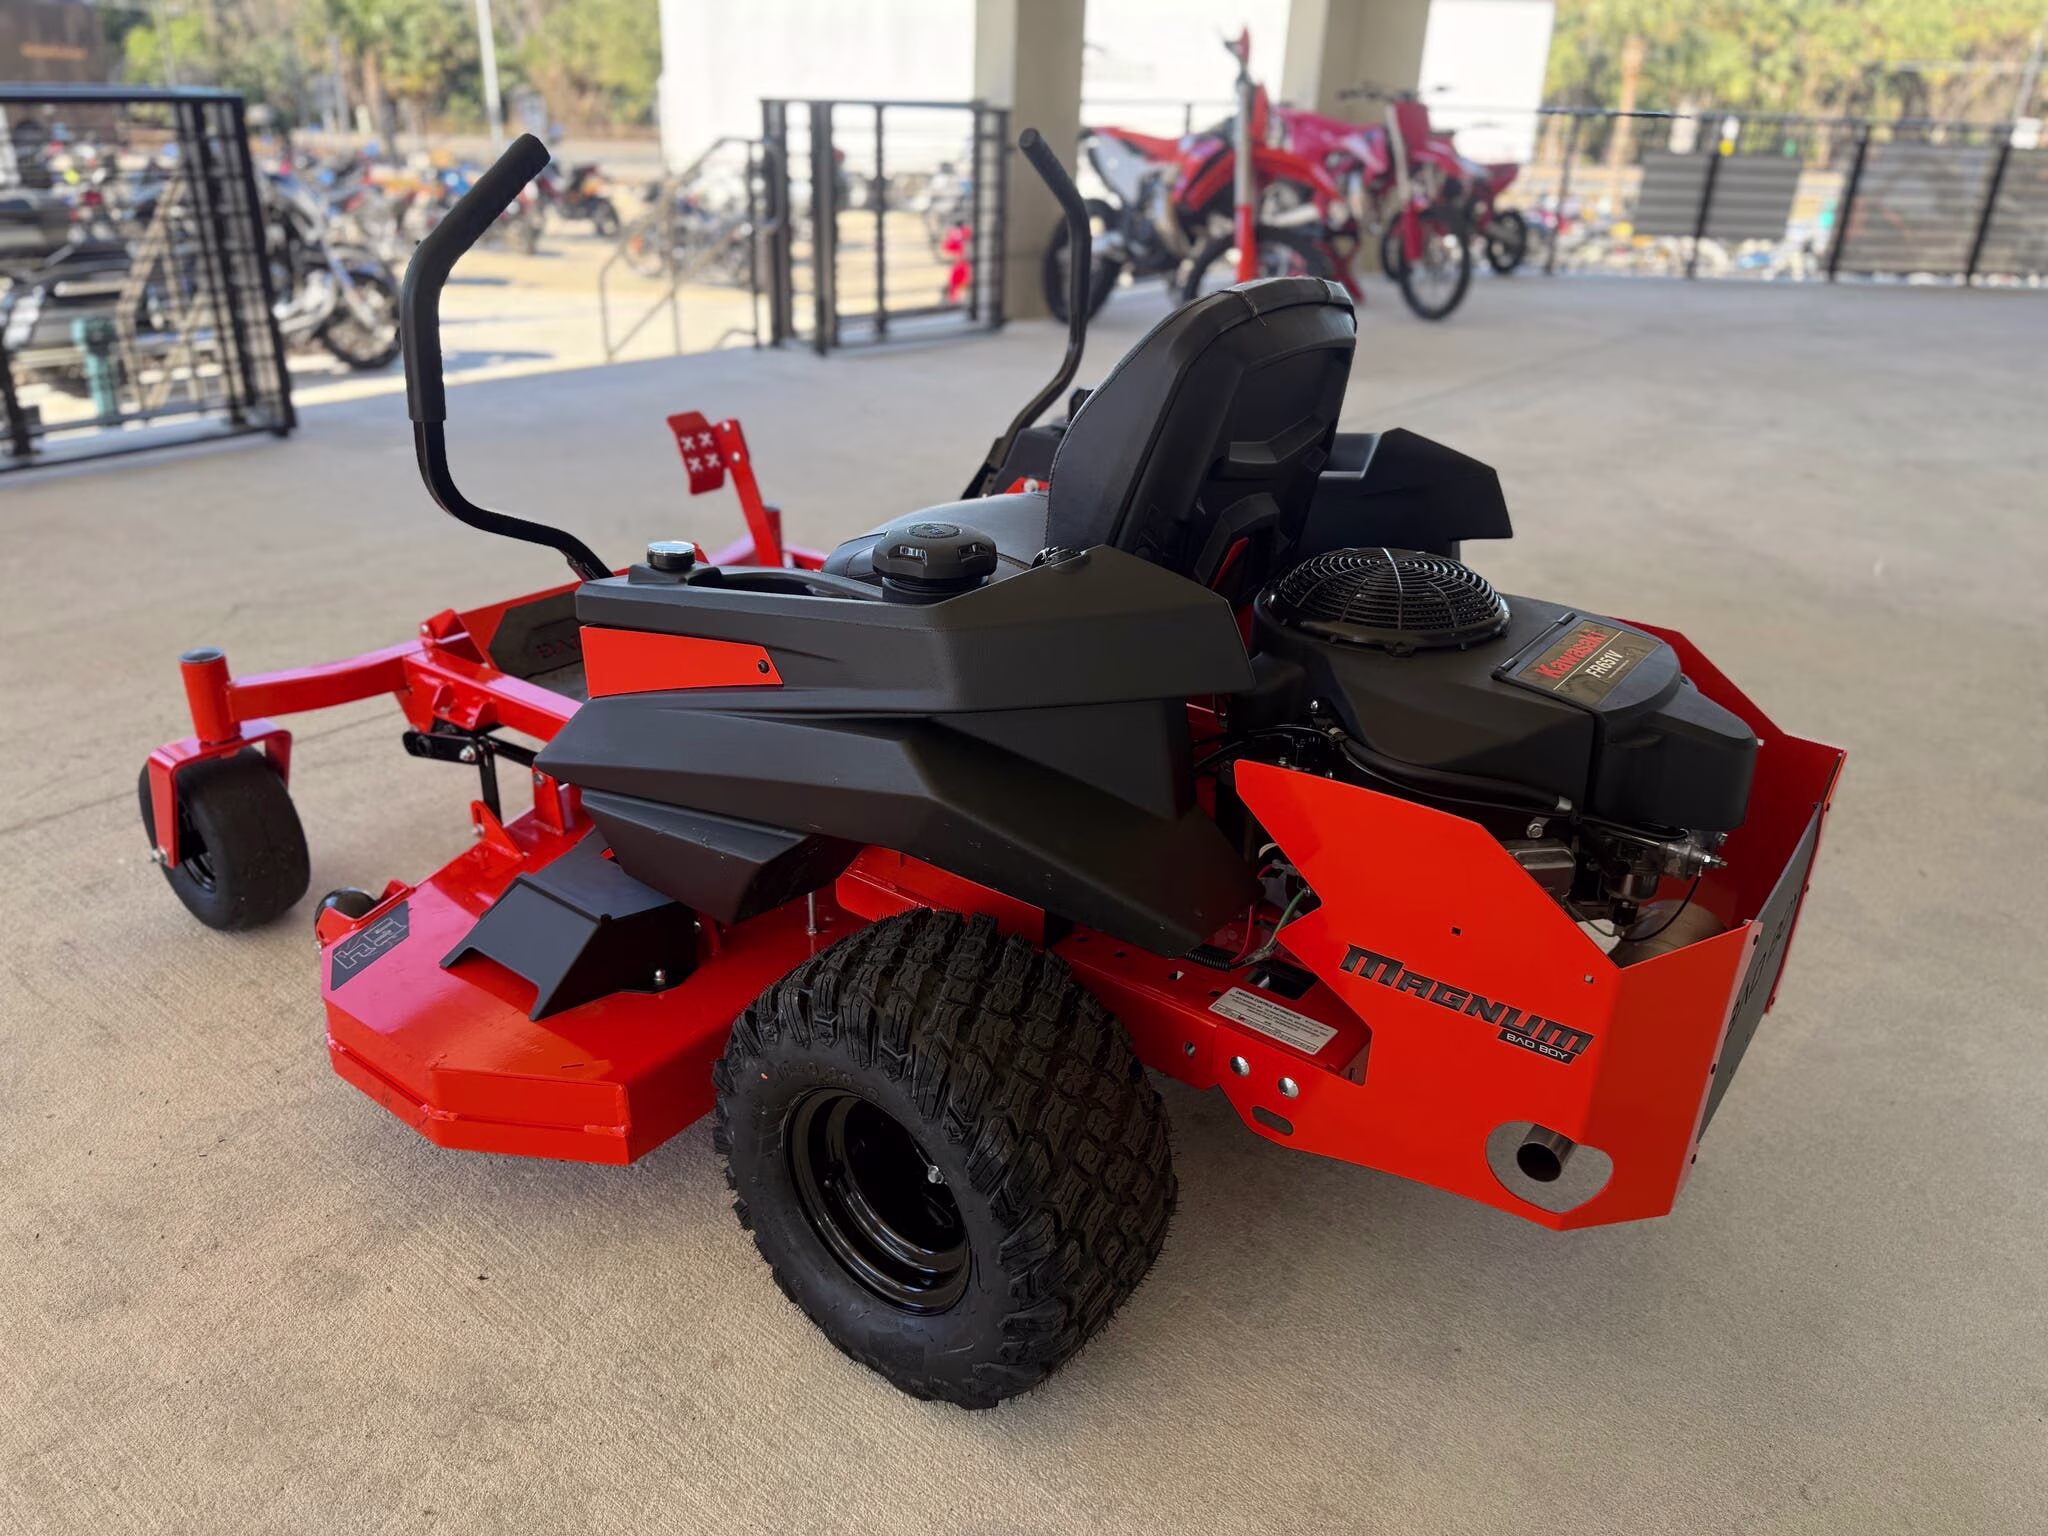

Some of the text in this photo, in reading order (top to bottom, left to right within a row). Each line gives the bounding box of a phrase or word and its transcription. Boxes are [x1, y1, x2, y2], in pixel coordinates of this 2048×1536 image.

[1536, 628, 1608, 679] Kawasaki
[1585, 649, 1623, 678] FR651V
[1339, 944, 1594, 1055] MAGNUM
[1506, 1032, 1568, 1060] BAD BOY
